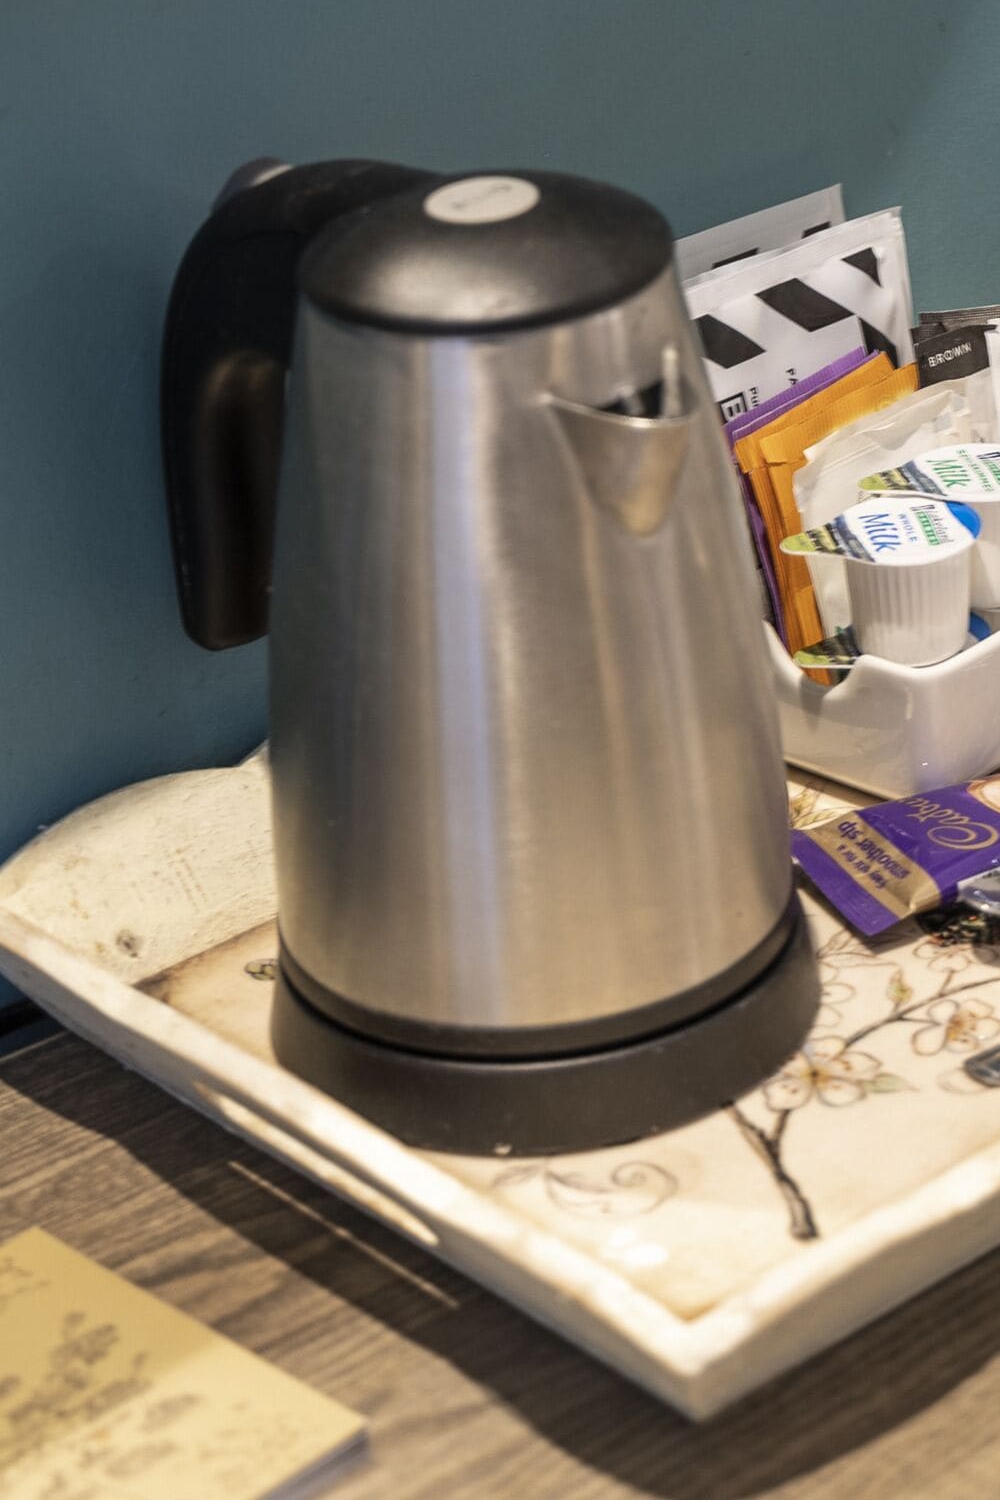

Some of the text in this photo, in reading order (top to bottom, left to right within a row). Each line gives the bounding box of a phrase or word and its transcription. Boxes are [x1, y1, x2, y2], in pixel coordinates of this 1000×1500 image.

[928, 342, 972, 368] BROWN
[926, 459, 972, 489] Milk
[858, 513, 902, 553] Milk
[898, 513, 918, 543] WHOLE
[859, 837, 911, 879] smoother
